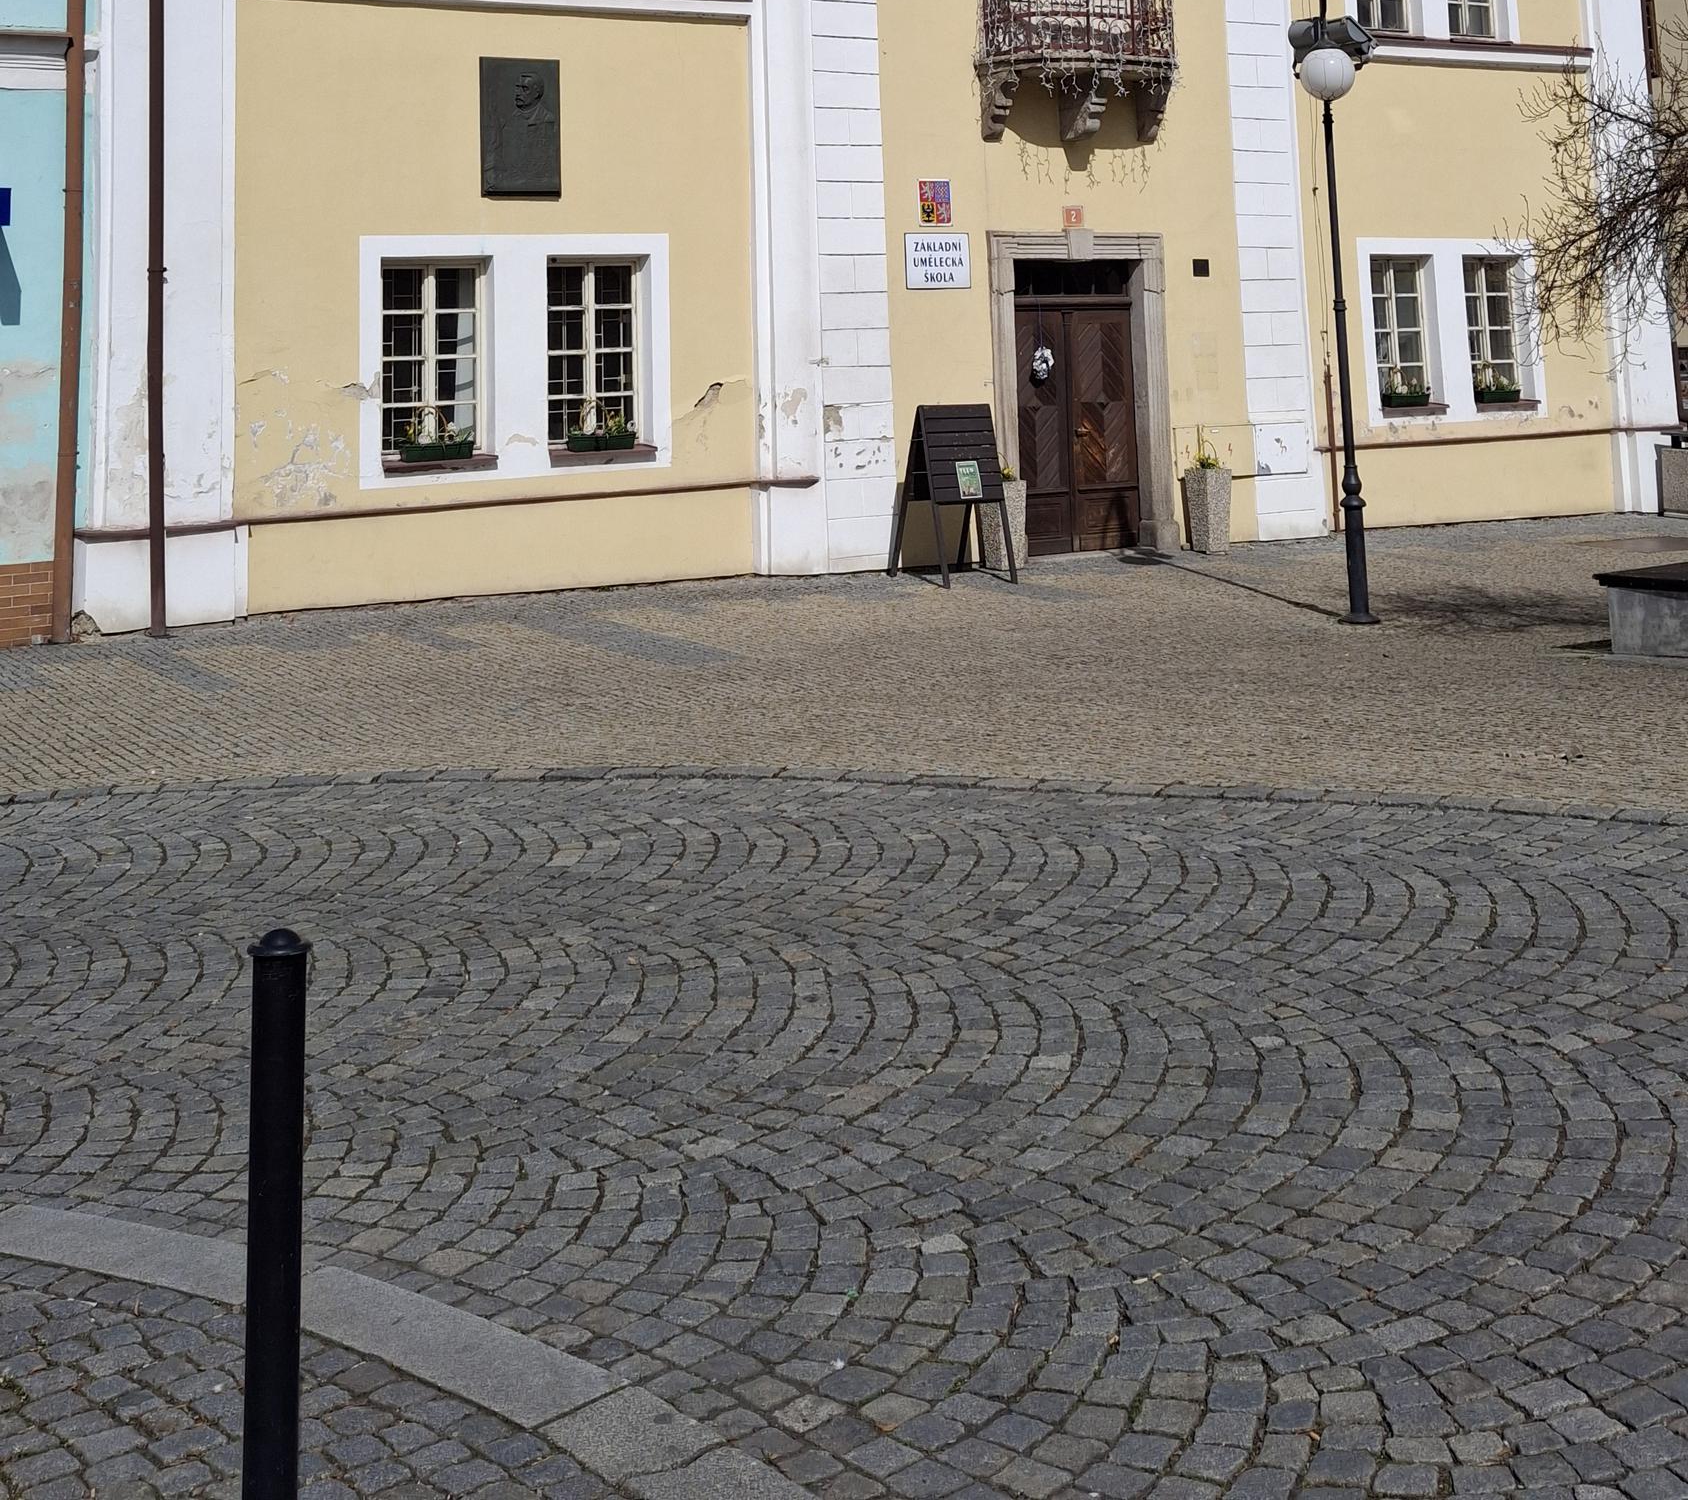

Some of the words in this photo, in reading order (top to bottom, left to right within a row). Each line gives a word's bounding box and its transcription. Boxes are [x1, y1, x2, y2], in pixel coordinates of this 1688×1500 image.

[1070, 210, 1077, 222] 2
[913, 239, 962, 252] ZÁKLADNÍ
[913, 254, 964, 267] UMĚLECKÁ
[924, 269, 955, 283] ŠKOLA
